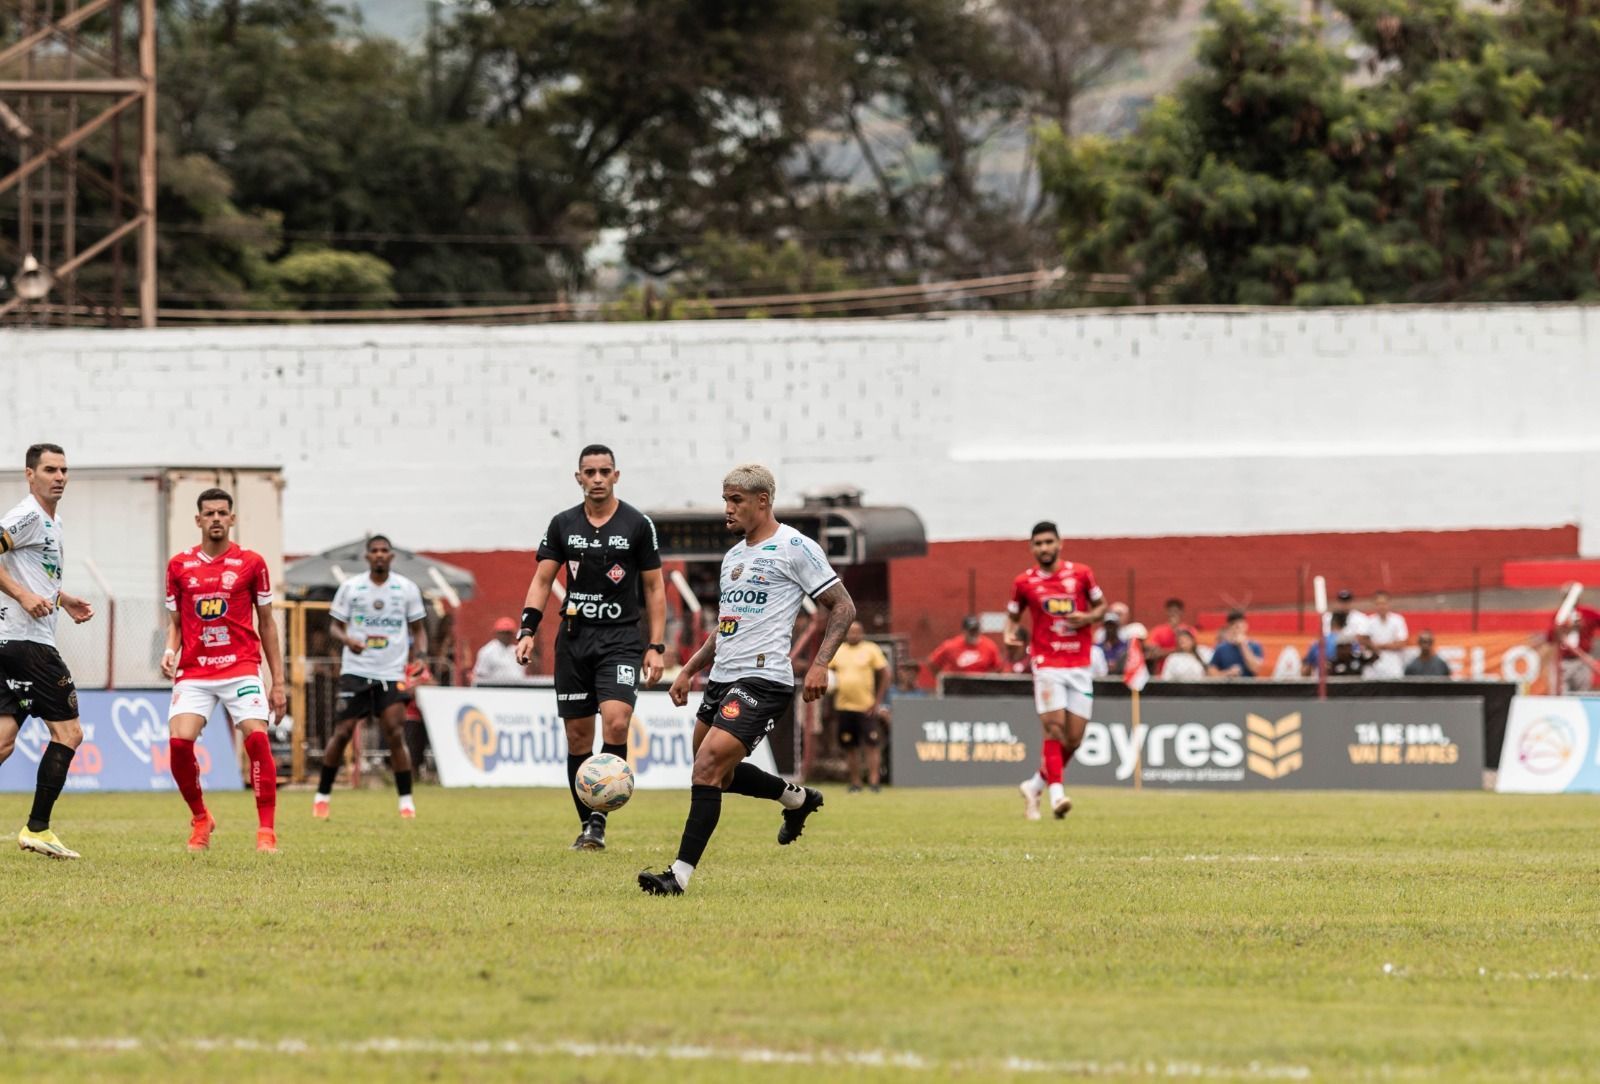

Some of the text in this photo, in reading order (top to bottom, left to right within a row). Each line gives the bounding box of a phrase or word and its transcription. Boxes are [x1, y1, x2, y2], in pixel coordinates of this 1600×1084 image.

[568, 537, 588, 546] MGL
[609, 538, 629, 547] MGL
[569, 591, 604, 601] internet
[201, 600, 222, 615] BH
[207, 654, 237, 665] SICOOB
[1075, 722, 1244, 780] ayres
